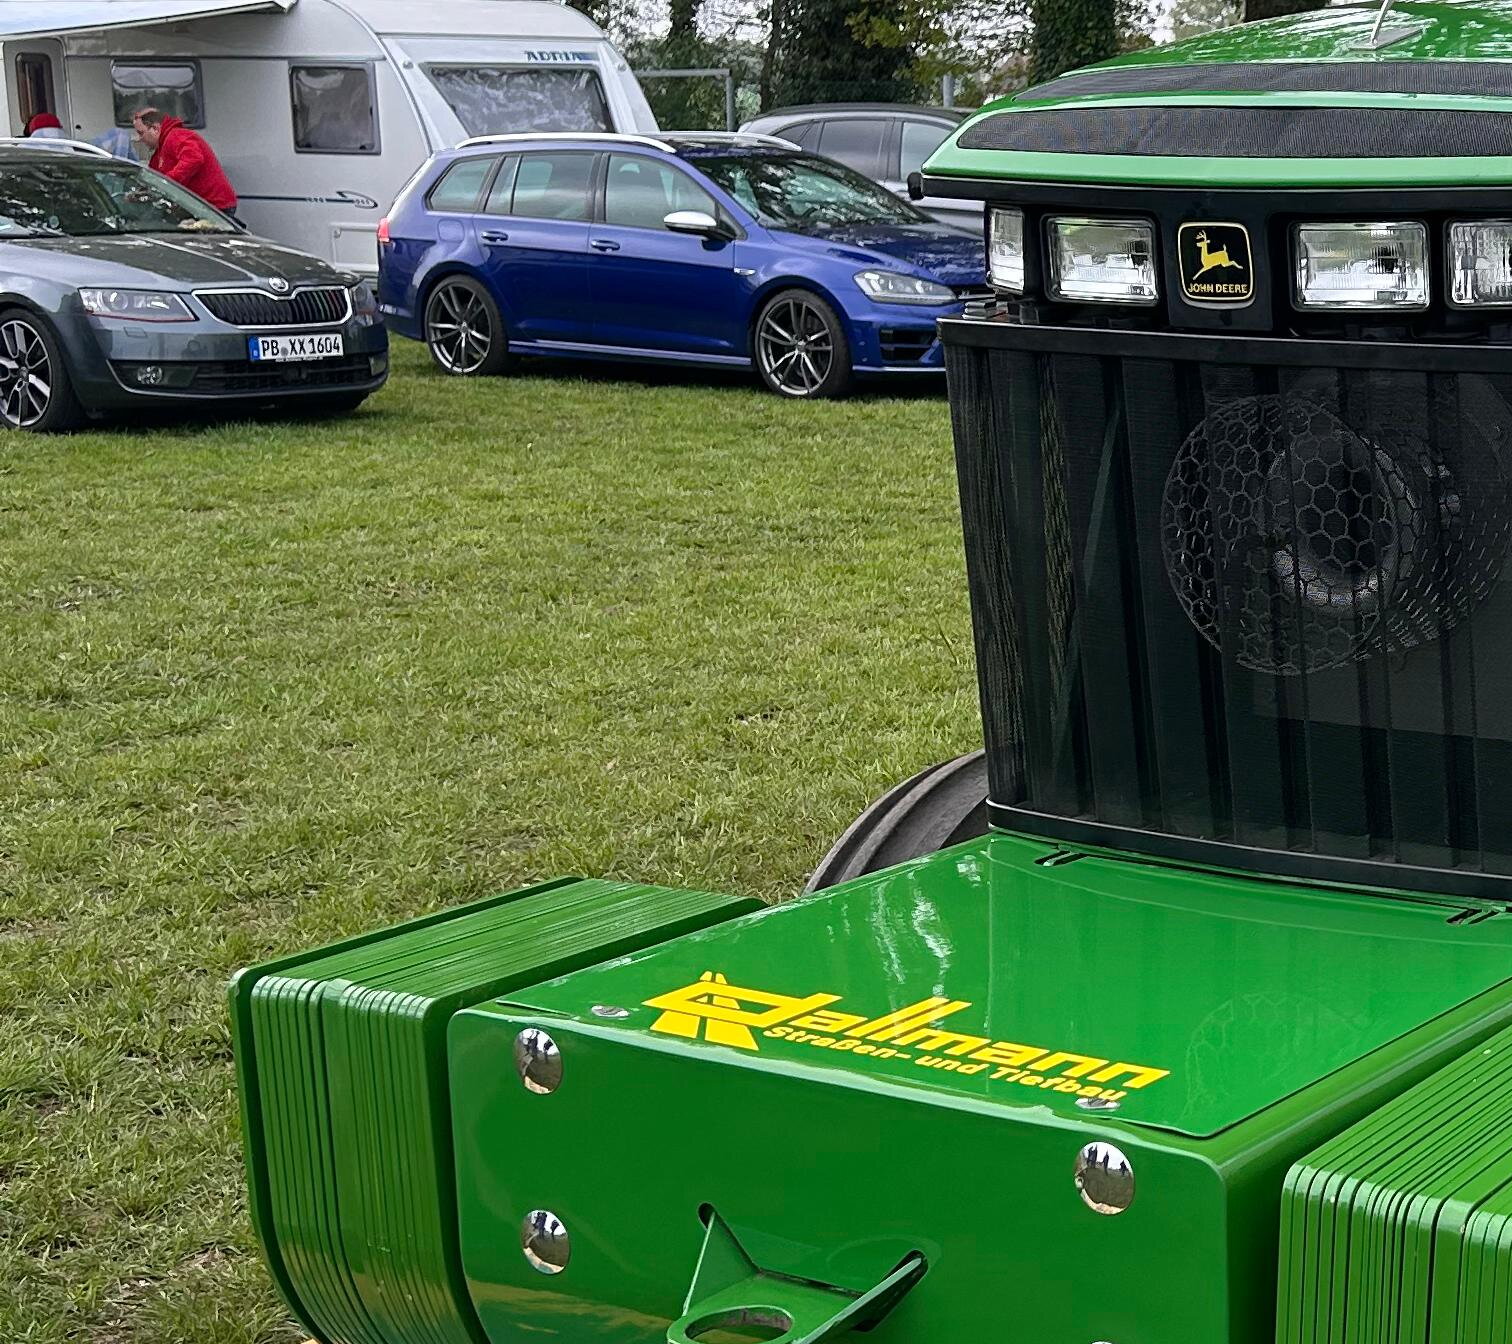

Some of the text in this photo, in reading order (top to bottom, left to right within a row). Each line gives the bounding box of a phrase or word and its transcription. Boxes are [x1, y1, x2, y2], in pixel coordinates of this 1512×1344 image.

[524, 51, 582, 61] ADRIA
[1187, 283, 1248, 294] JOHN DEERE
[261, 336, 340, 357] PB XX 1604
[763, 1026, 1127, 1101] Straßen- und Tiefbau
